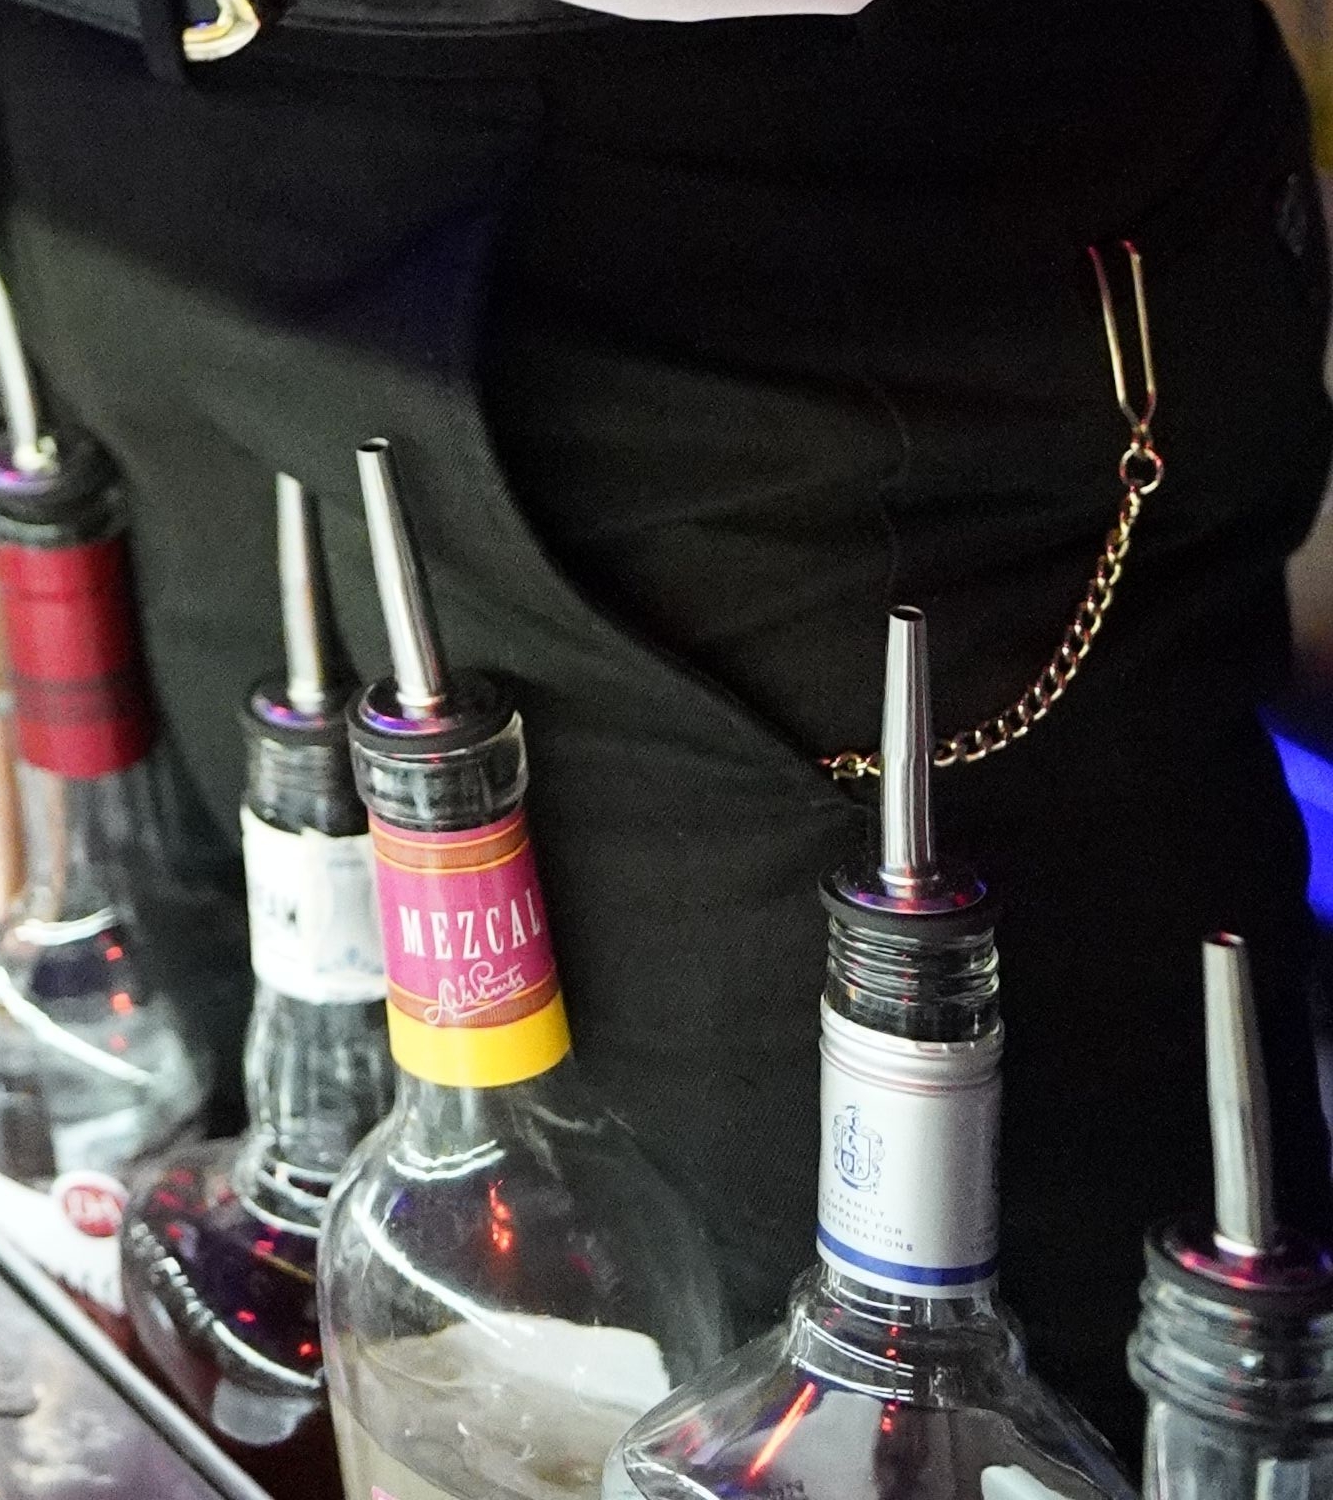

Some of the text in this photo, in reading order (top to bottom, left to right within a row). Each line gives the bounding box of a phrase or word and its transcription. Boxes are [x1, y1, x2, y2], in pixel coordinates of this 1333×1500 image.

[398, 888, 541, 960] MEZCAL
[839, 1192, 885, 1218] FAMILY
[874, 1221, 903, 1237] FOR
